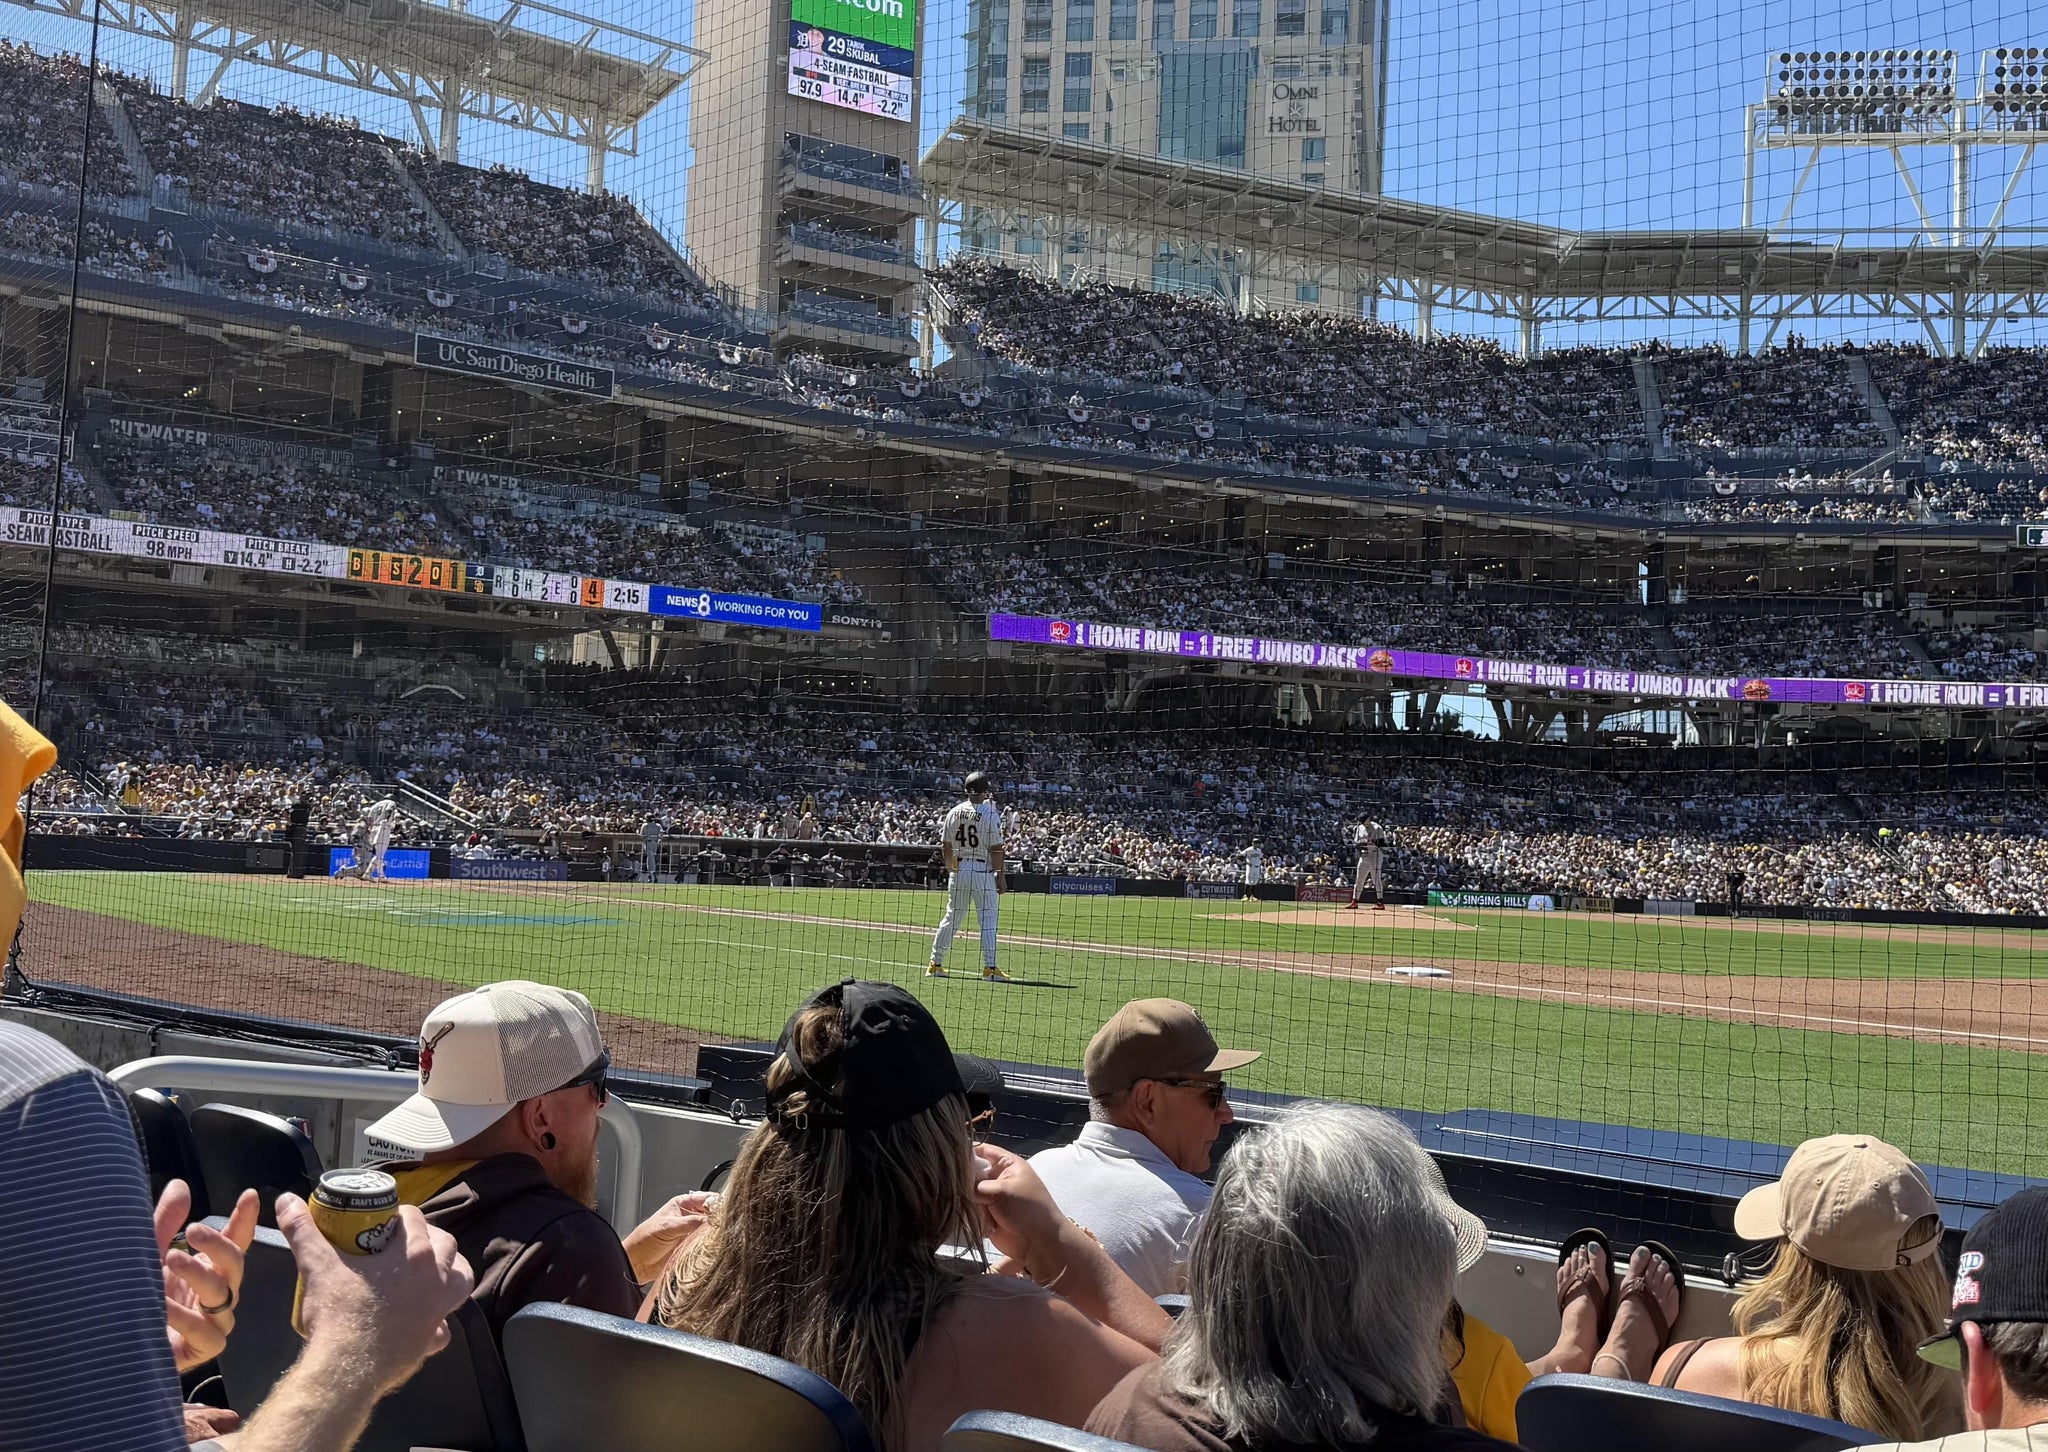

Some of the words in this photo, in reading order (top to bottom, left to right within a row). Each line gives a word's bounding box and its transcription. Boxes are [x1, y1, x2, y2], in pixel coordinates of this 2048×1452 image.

[827, 36, 846, 54] 29
[846, 48, 881, 65] SKUBAL
[814, 58, 846, 77] 4-SEAM
[848, 66, 890, 87] FASTBALL
[800, 80, 822, 98] 97.9
[837, 88, 865, 107] 14.4"
[1274, 83, 1320, 100] OMNI
[877, 99, 903, 116] -2.2"
[1268, 116, 1322, 133] HOTEL
[438, 342, 465, 364] UC
[466, 349, 498, 369] San
[499, 355, 545, 381] Diego
[546, 364, 596, 389] Health
[60, 516, 84, 529] TYPE
[0, 523, 45, 545] -SEAM
[135, 525, 164, 539] PITCH
[166, 528, 197, 542] SPEED
[146, 540, 165, 558] 98
[167, 545, 192, 560] MPH
[248, 538, 275, 551] PITCH
[277, 542, 308, 555] BREAK
[227, 552, 235, 563] V
[240, 551, 273, 568] 14.4"
[285, 558, 292, 569] H
[297, 559, 329, 574] -2.2"
[353, 557, 361, 571] B
[371, 552, 380, 580] 1
[392, 561, 400, 576] S
[407, 557, 423, 585] 2
[450, 562, 459, 589] 1
[495, 575, 503, 588] R
[524, 578, 532, 591] H
[555, 582, 561, 595] E
[512, 569, 520, 582] 6
[541, 572, 549, 585] 7
[571, 575, 578, 588] 0
[511, 583, 519, 597] 0
[541, 587, 549, 601] 2
[570, 590, 577, 604] 0
[588, 581, 597, 599] 4
[613, 587, 640, 605] 2:15
[713, 599, 763, 616] WORKING
[764, 606, 785, 619] FOR
[787, 609, 810, 621] YOU
[831, 614, 870, 627] SONY
[1075, 623, 1085, 645] 1
[1088, 624, 1141, 649] HOME
[1143, 629, 1181, 652] RUN
[1199, 634, 1209, 656] 1
[1212, 636, 1253, 660] FREE
[1256, 639, 1315, 665] JUMBO
[1476, 660, 1485, 680] 1
[1488, 661, 1533, 684] HOME
[1535, 666, 1567, 687] RUN
[1582, 669, 1591, 689] 1
[1594, 671, 1631, 692] FREE
[1632, 673, 1683, 697] JUMBO
[1869, 683, 1881, 703] 1
[1884, 684, 1941, 705] HOME
[1943, 685, 1984, 706] RUN
[2004, 687, 2016, 706] 1
[955, 823, 979, 848] 46
[460, 862, 545, 880] Southwest
[1052, 881, 1104, 892] citycruises
[1201, 885, 1235, 894] CUTWATER
[1462, 894, 1501, 906] SINGING
[1503, 896, 1527, 907] HILLS
